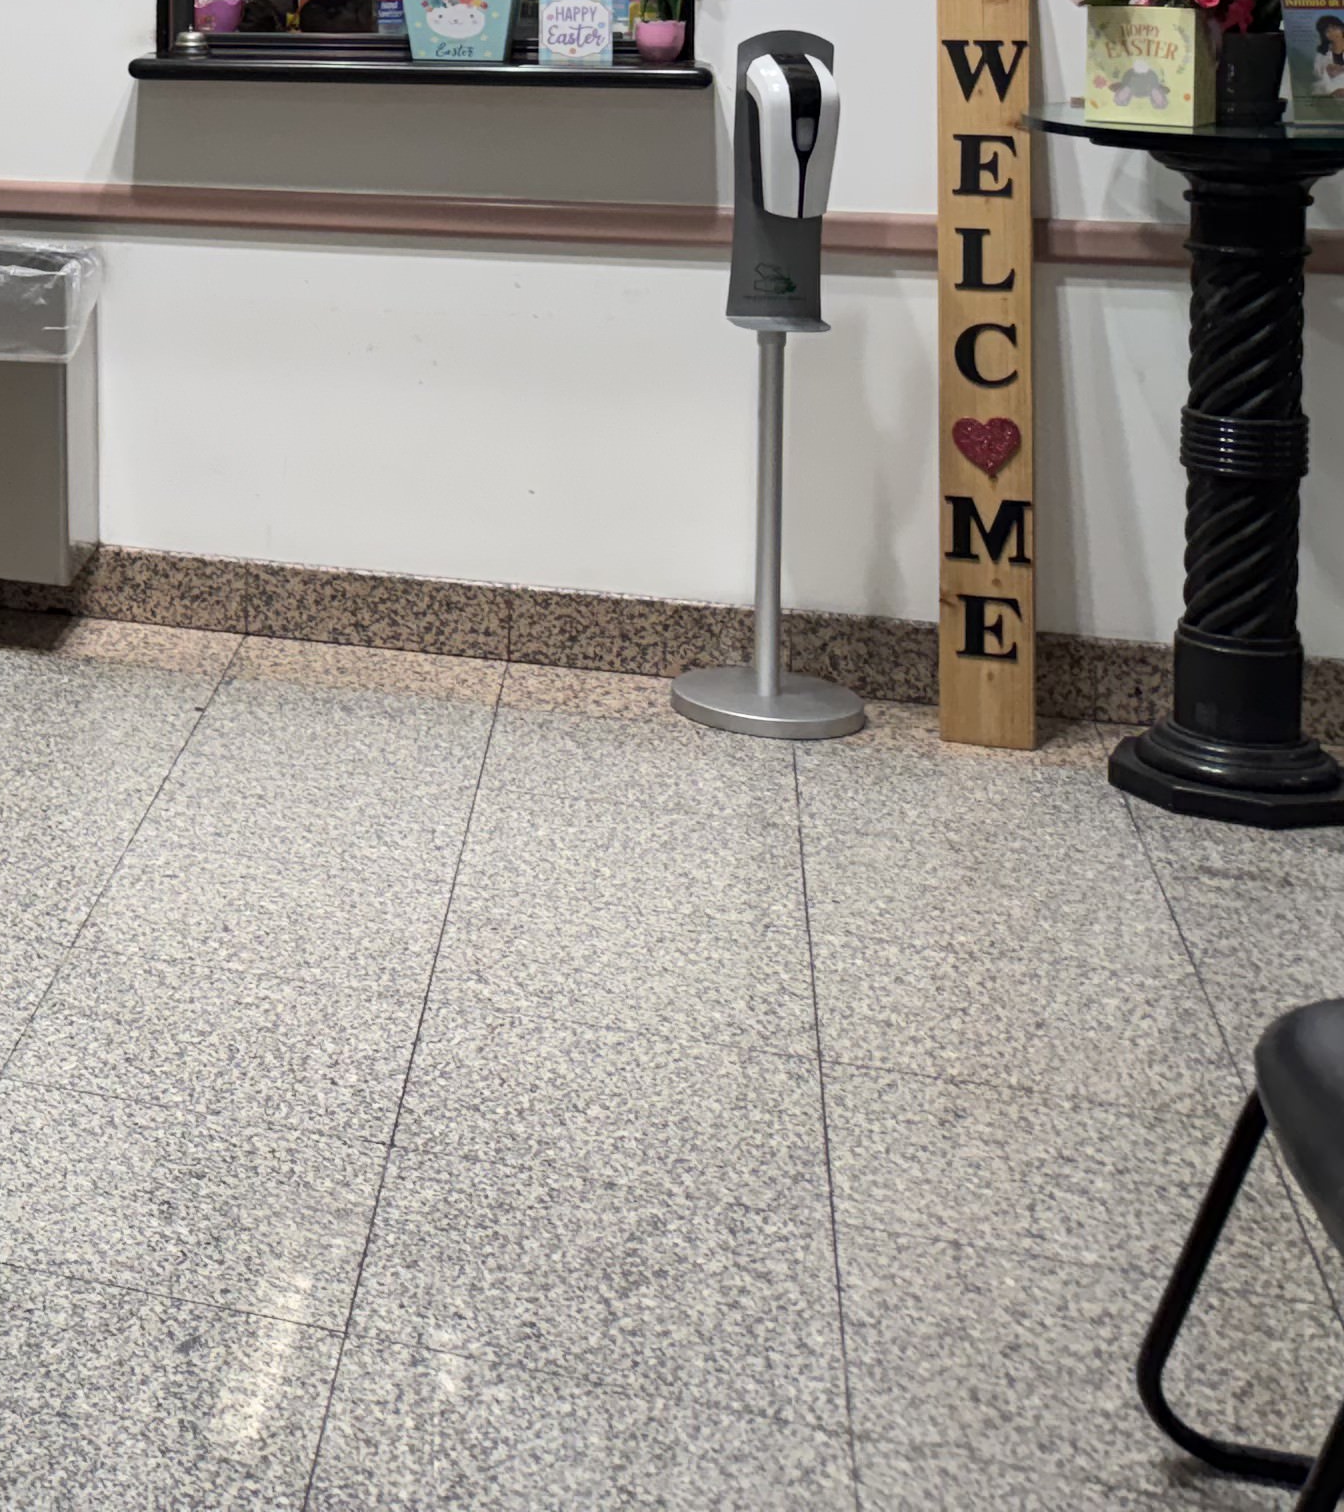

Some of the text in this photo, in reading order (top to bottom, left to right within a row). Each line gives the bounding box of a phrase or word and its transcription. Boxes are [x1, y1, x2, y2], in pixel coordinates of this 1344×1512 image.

[555, 6, 597, 22] HAPPY
[547, 24, 605, 48] Easter
[1121, 23, 1160, 38] HOPPY
[435, 42, 474, 57] Easter
[1105, 39, 1179, 61] EASTER
[942, 39, 1032, 662] WELCME
